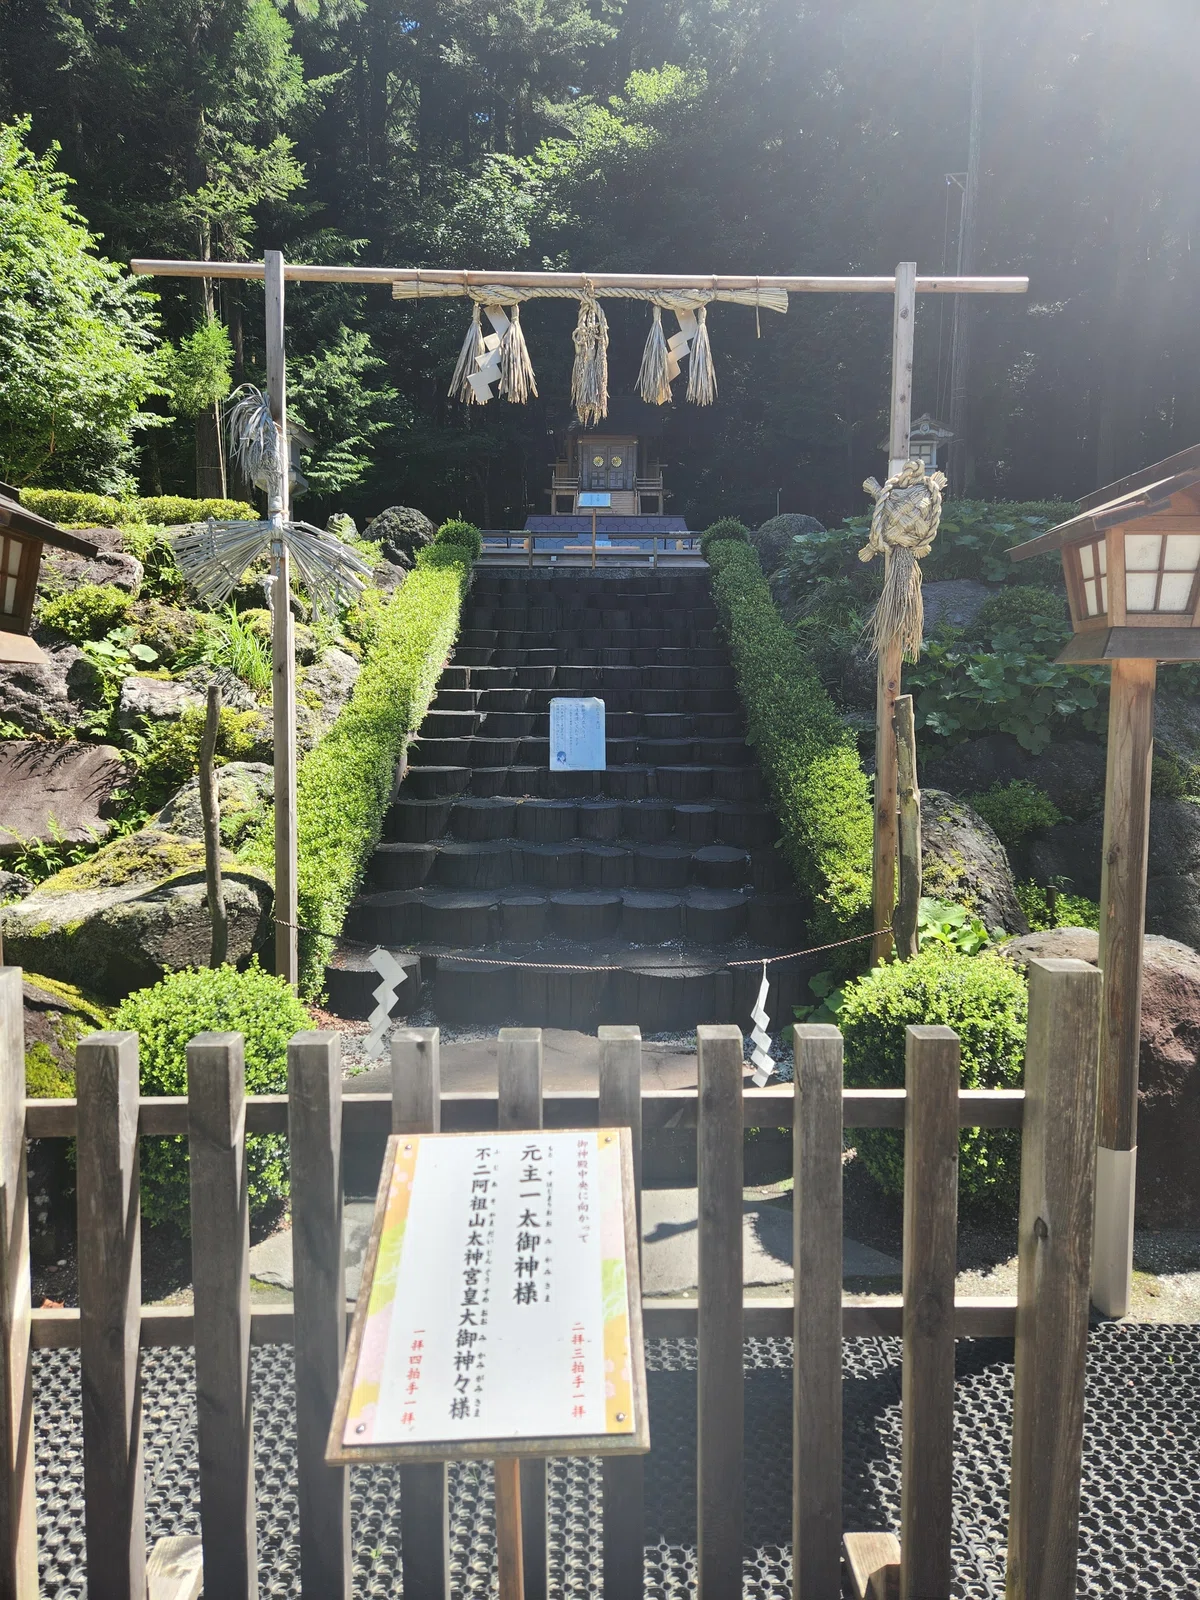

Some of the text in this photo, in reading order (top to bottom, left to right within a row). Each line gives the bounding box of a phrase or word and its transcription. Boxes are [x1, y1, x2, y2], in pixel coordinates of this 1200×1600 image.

[448, 1147, 491, 1421] 不二阿祖山太神宮皇大御神々様
[513, 1144, 543, 1305] 元主一太御神様
[400, 1329, 426, 1425] 一拝四拍手一拝
[571, 1321, 586, 1418] 二拝三拍手一拝
